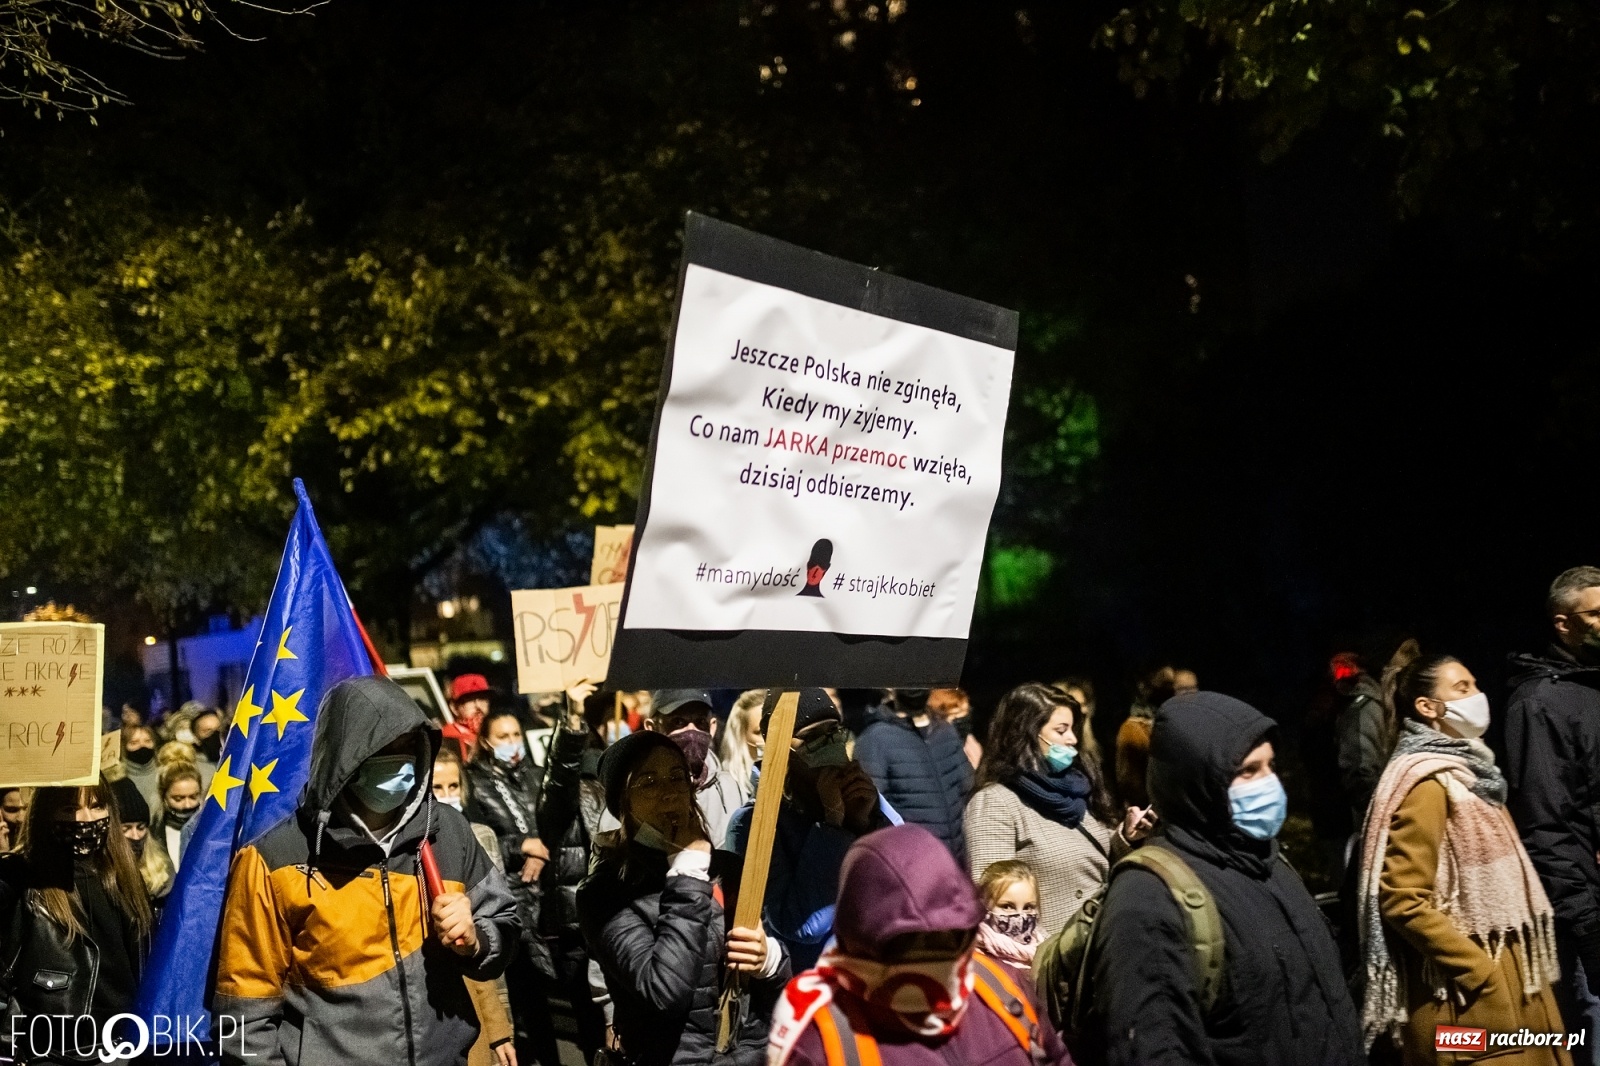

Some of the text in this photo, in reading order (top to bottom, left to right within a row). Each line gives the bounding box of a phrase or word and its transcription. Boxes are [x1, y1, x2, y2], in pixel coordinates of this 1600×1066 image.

[730, 339, 962, 412] Jeszcze Polska nie zginęła,
[762, 386, 918, 439] Kiedy my żyjemy.
[689, 414, 972, 485] Co nam JARKA przemoc wzięła,
[740, 463, 915, 511] dzisiaj odbierzemy.
[695, 562, 801, 591] #mamydość
[848, 574, 936, 599] strajkkobiet
[42, 633, 97, 656] RÓŻE
[0, 660, 16, 681] E
